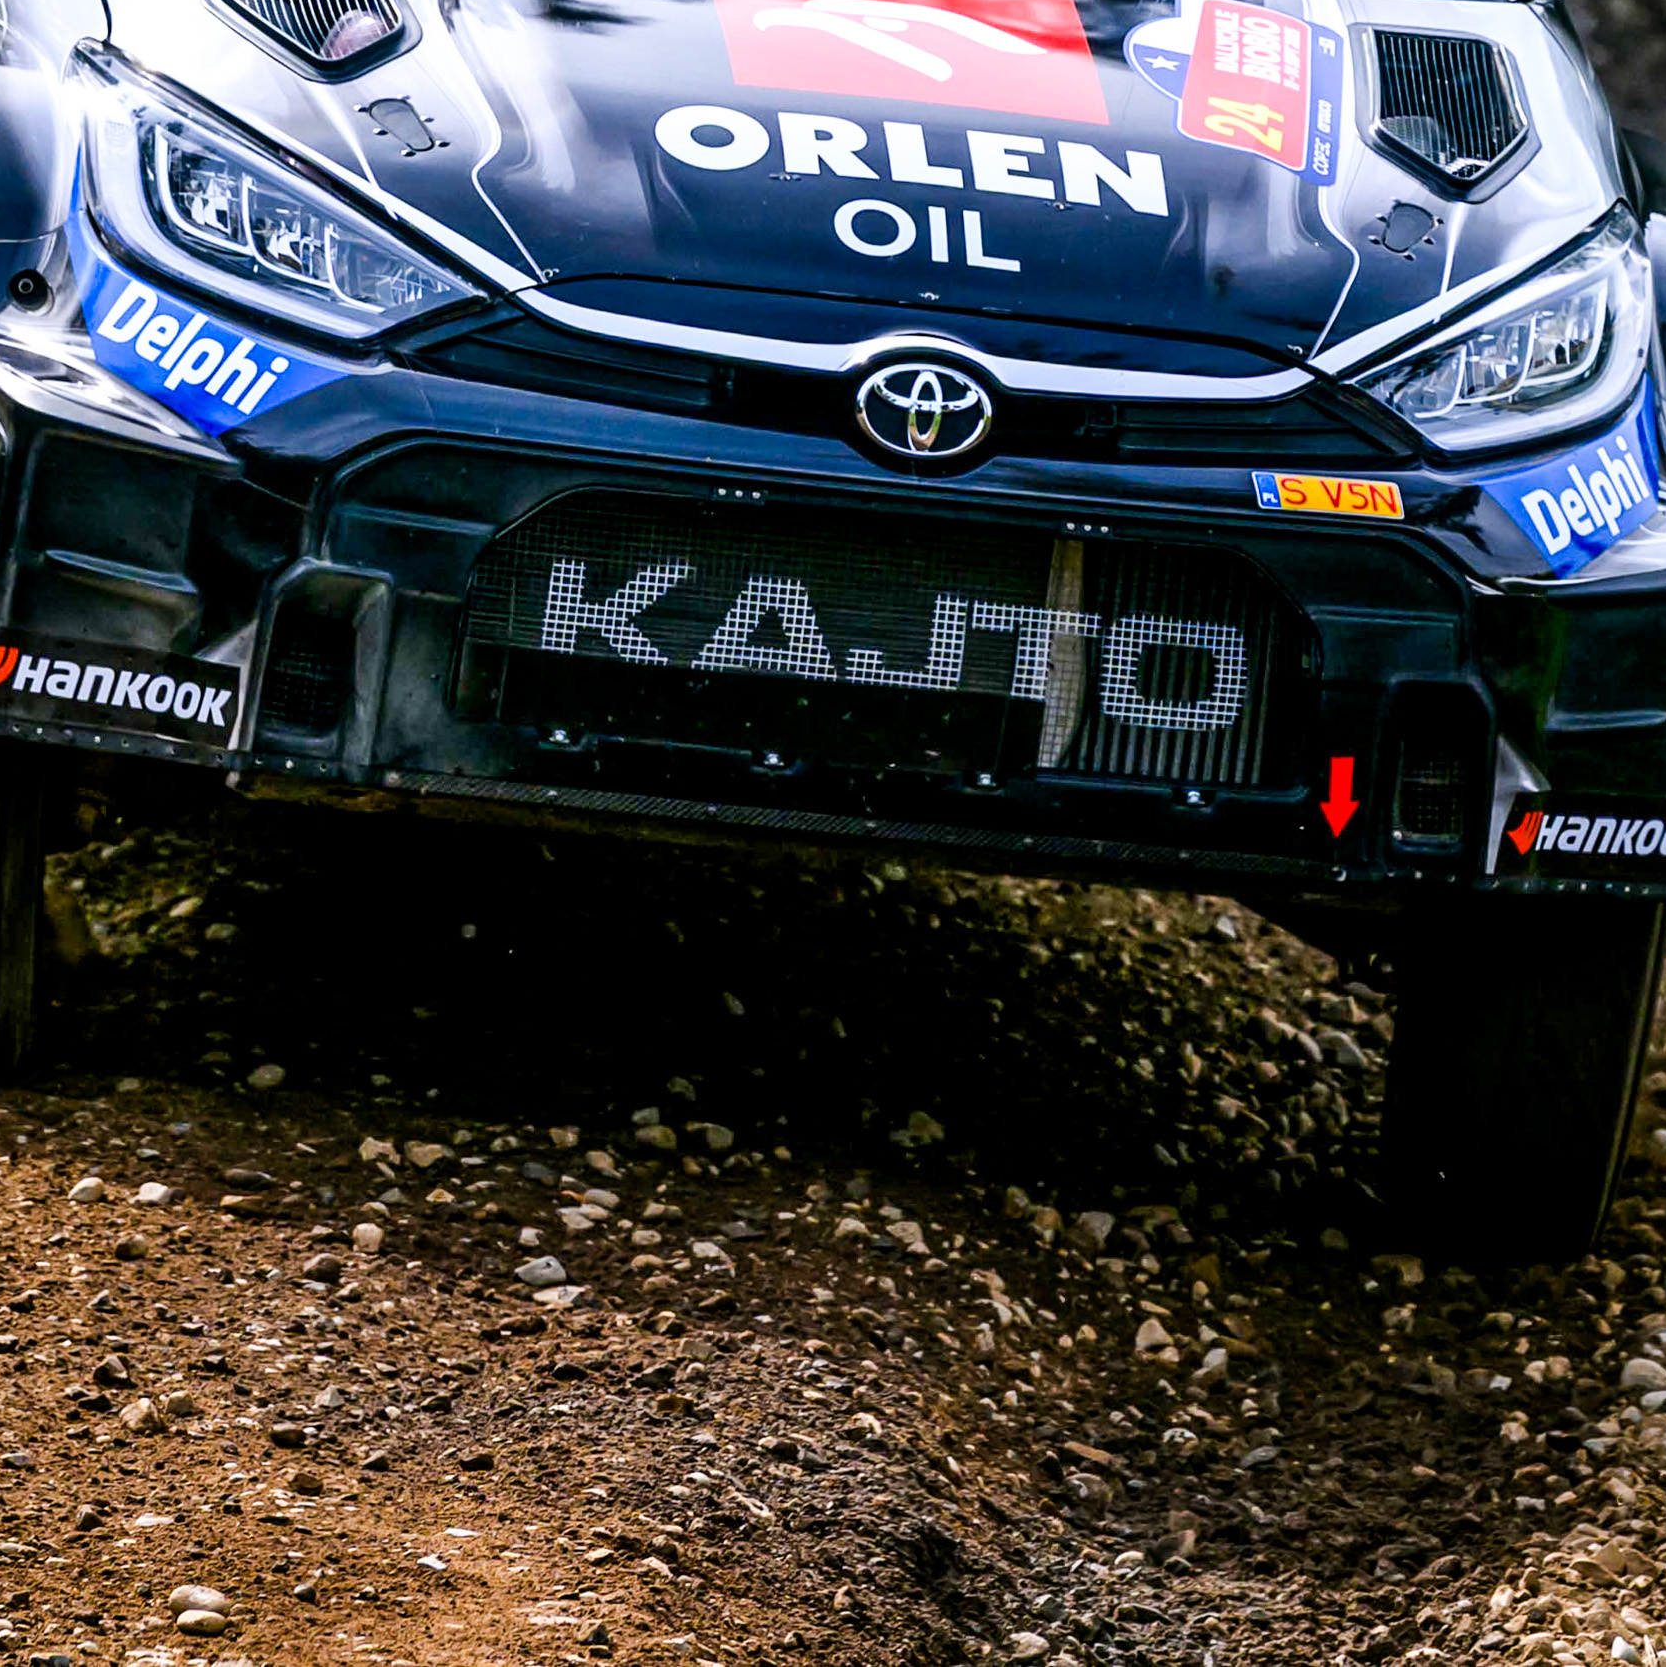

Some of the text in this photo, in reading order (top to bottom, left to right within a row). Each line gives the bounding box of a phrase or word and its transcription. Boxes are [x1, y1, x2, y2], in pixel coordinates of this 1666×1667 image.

[655, 105, 1169, 216] ORLEN
[1204, 96, 1284, 153] 24
[834, 199, 1020, 272] OIL
[97, 279, 290, 415] Delphi
[1262, 478, 1397, 513] PL S V5N
[1521, 436, 1650, 555] Delphi
[541, 557, 1247, 731] KAJTO
